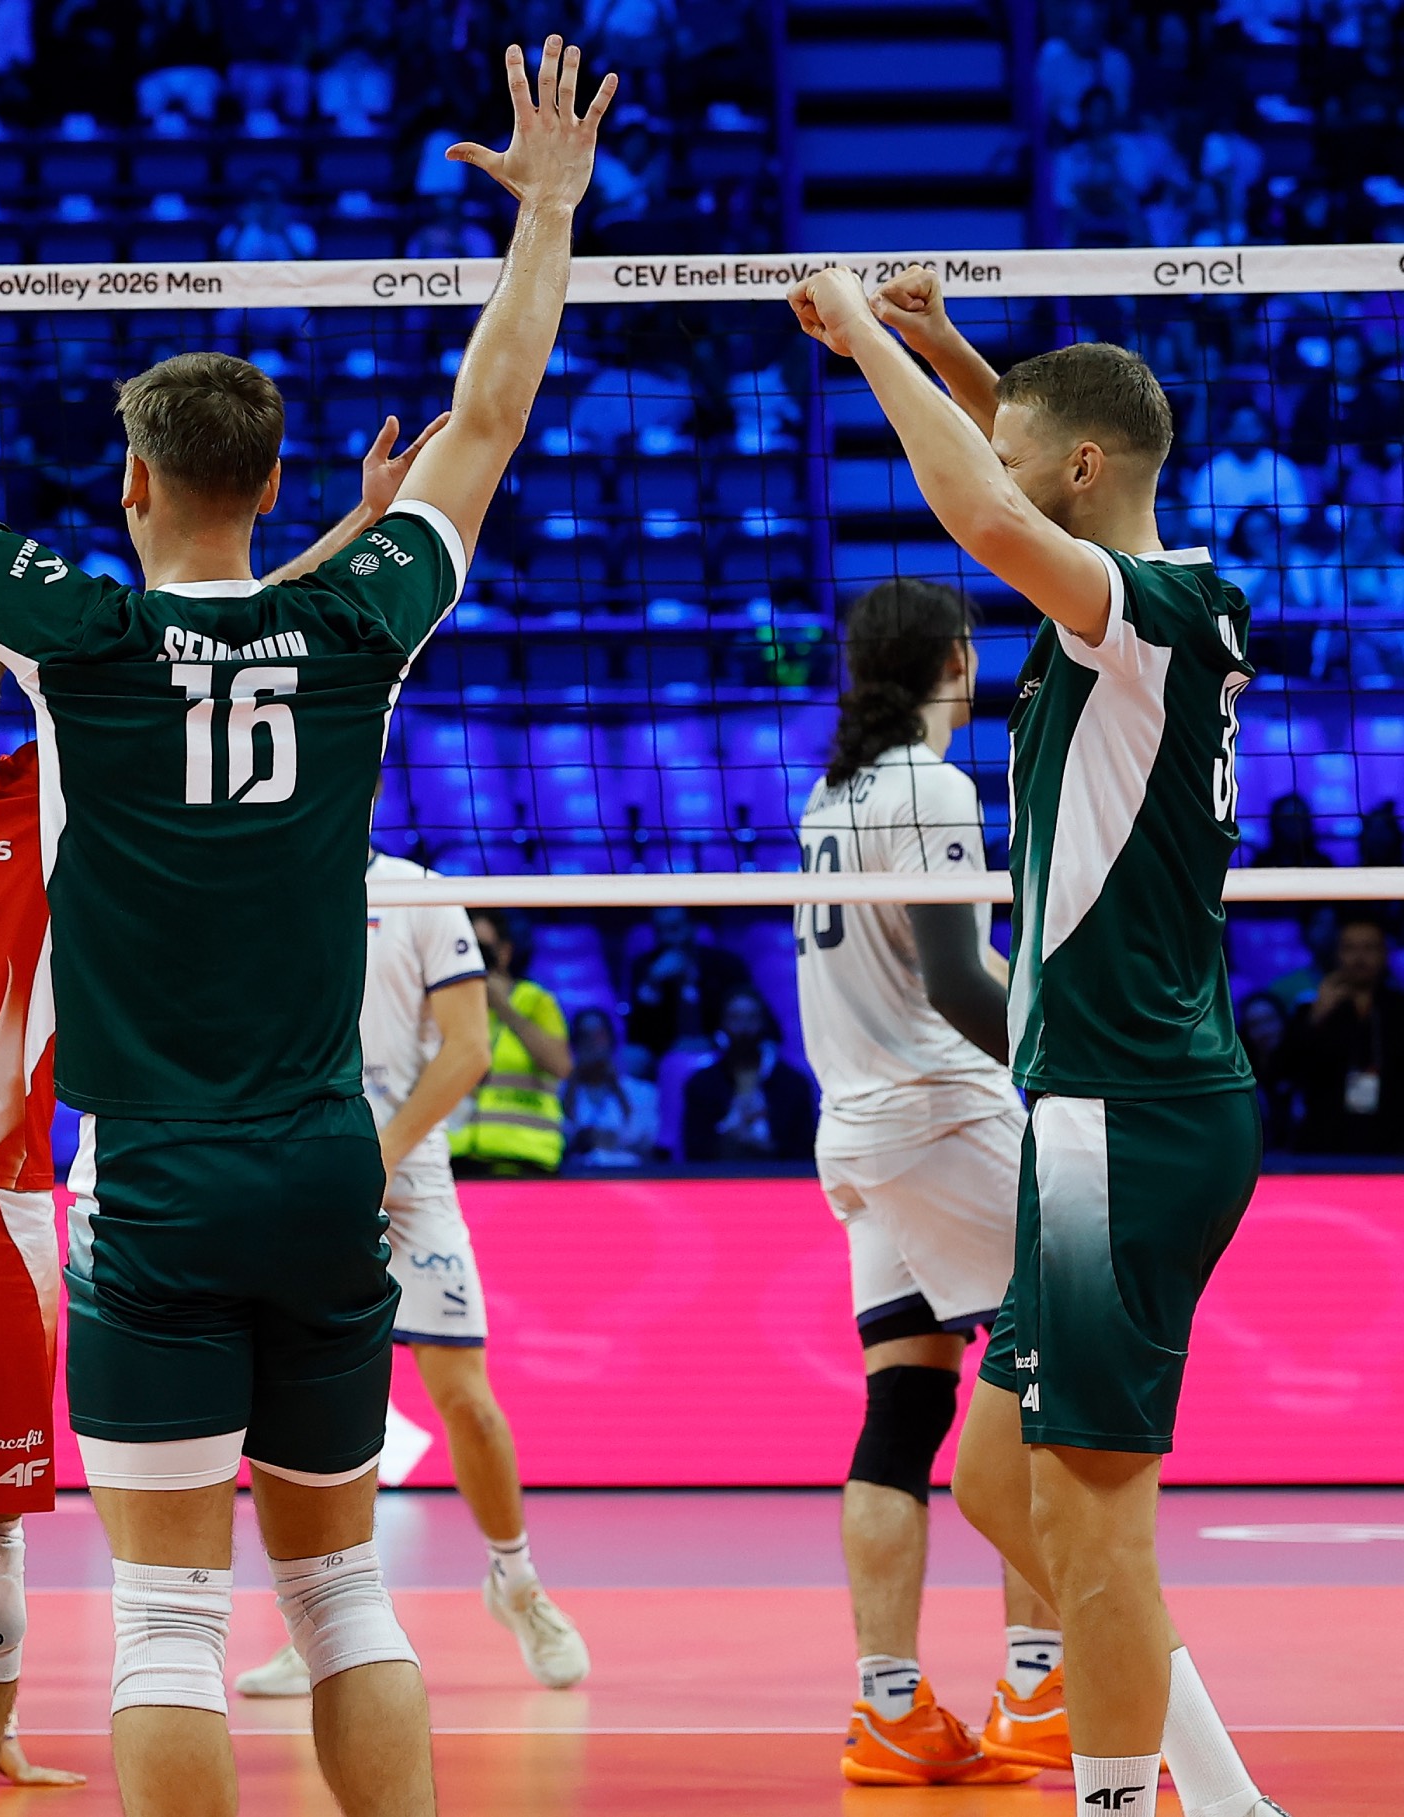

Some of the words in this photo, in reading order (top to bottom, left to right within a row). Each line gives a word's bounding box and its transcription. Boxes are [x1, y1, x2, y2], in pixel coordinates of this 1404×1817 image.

[98, 272, 159, 294] 2026
[166, 272, 223, 294] Men
[372, 265, 462, 298] enel
[614, 264, 667, 287] CEV
[675, 263, 726, 286] Enel
[945, 260, 1002, 282] Men
[1154, 253, 1244, 286] enel
[9, 538, 39, 579] ORLEN
[366, 532, 414, 567] plus
[171, 663, 298, 805] 16
[321, 1552, 344, 1568] 16
[186, 1569, 210, 1584] 16
[1084, 1785, 1146, 1810] 4F
